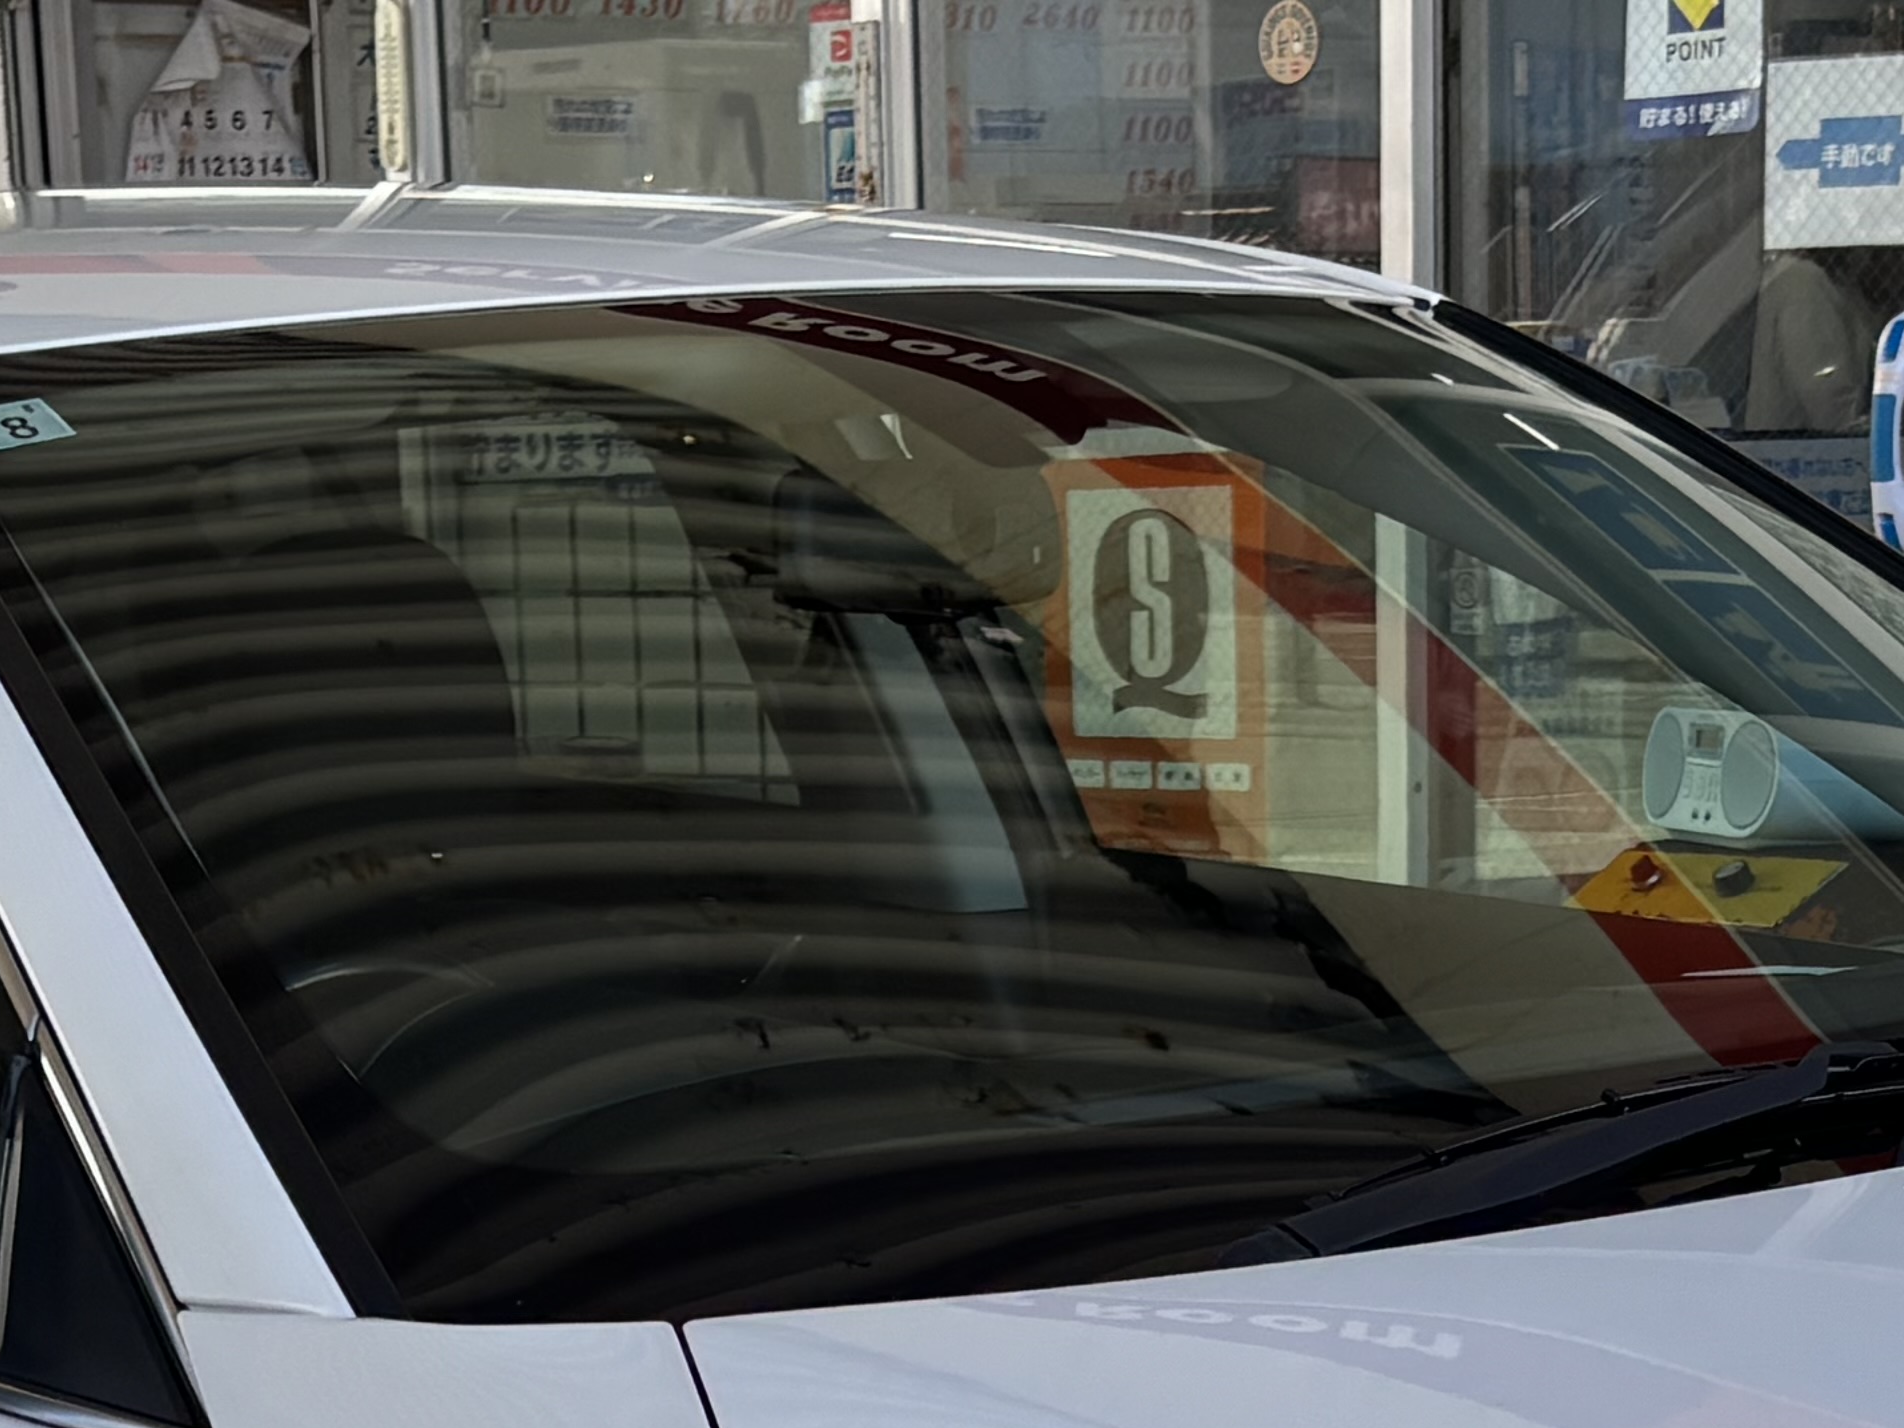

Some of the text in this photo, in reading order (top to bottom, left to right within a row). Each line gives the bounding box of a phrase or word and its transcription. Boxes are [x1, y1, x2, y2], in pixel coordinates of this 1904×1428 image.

[1666, 37, 1727, 63] POINT
[181, 109, 275, 130] 4 5 6 7
[1123, 114, 1193, 144] 1100
[177, 156, 196, 177] 11
[202, 155, 226, 177] 12
[228, 155, 255, 177] 13
[259, 155, 285, 177] 14
[1820, 143, 1896, 168] 手動です
[0, 416, 40, 439] 8
